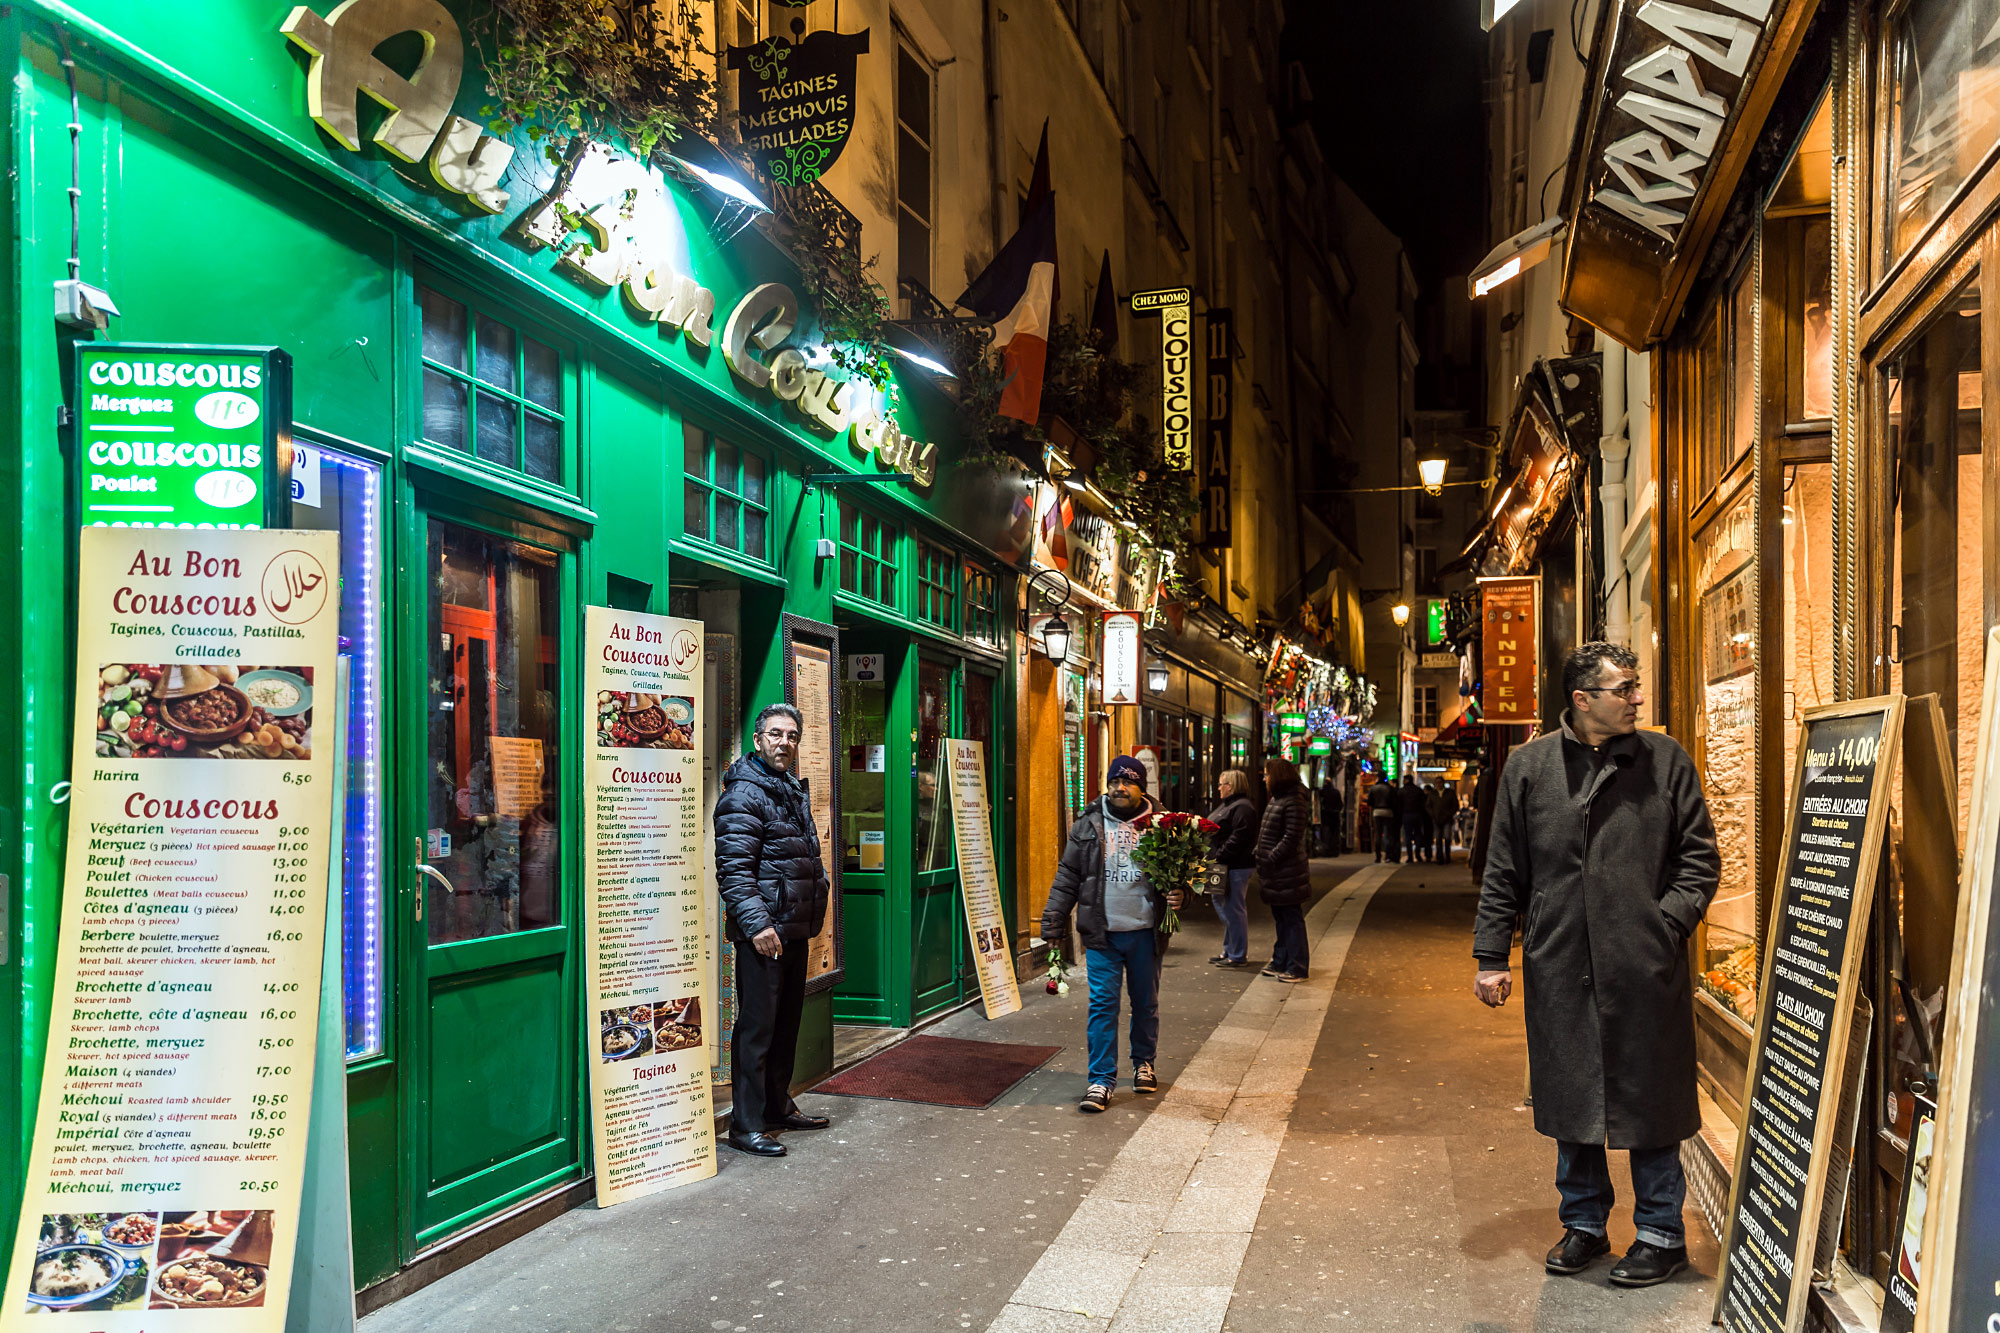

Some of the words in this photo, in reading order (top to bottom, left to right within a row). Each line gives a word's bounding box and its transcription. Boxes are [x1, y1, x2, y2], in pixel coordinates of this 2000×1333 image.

[757, 73, 838, 104] TAGINES
[750, 118, 849, 151] GRILLADES
[1135, 295, 1158, 306] CHEZ
[1159, 292, 1187, 304] MOMO
[89, 362, 261, 388] couscous
[91, 395, 173, 415] Merguez
[88, 441, 261, 468] couscous
[1209, 374, 1229, 533] BAR
[91, 474, 157, 492] Poulet
[128, 550, 172, 576] Au
[183, 551, 241, 578] Bon
[113, 587, 256, 616] Couscous
[111, 623, 165, 637] Tagines,
[172, 624, 236, 637] Couscous,
[244, 626, 304, 638] Pastillas,
[610, 623, 630, 640] Au
[636, 626, 662, 644] Bon
[176, 645, 240, 657] Grillades
[603, 645, 669, 666] Couscous
[602, 666, 626, 675] Tagines,
[1498, 622, 1518, 713] INDIEN
[633, 681, 662, 690] Grillades
[1805, 748, 1829, 767] Menu
[1829, 747, 1835, 767] à
[955, 759, 980, 771] Couscous
[94, 770, 138, 781] Harira
[283, 772, 311, 785] 6,50
[613, 767, 681, 784] Couscous
[125, 792, 278, 819] Couscous
[1803, 794, 1832, 812] ENTRÉES
[1831, 798, 1843, 812] AU
[1843, 798, 1868, 814] CHOIX
[91, 823, 163, 836] Végétarien
[280, 827, 309, 837] 9,00
[1811, 816, 1828, 828] Starters
[1833, 818, 1849, 830] choice
[89, 839, 145, 852] Merguez
[150, 843, 158, 851] (3
[162, 842, 192, 851] pièces)
[278, 843, 308, 851] 11,00
[88, 855, 125, 868] Bœuf
[130, 859, 151, 867] (Beef
[274, 858, 307, 869] 13,00
[87, 871, 130, 881] Poulet
[275, 874, 306, 883] 11,00
[1105, 870, 1142, 882] PARIS
[86, 887, 148, 897] Boulettes
[274, 890, 305, 898] 11,00
[84, 902, 118, 913] Côtes
[124, 903, 188, 916] d'agneau
[194, 906, 202, 915] (3
[206, 906, 238, 915] pièces)
[270, 906, 304, 916] 14,00
[81, 930, 135, 940] Berbere
[268, 930, 302, 941] 16,00
[76, 981, 142, 992] Brochette
[147, 981, 211, 994] d'agneau
[264, 983, 298, 994] 14,00
[73, 1009, 142, 1020] Brochette,
[149, 1009, 177, 1019] côte
[183, 1009, 247, 1022] d'agneau
[261, 1008, 296, 1019] 16,00
[1776, 990, 1795, 1012] PLATS
[1794, 1000, 1805, 1016] AU
[1804, 1004, 1826, 1028] CHOIX
[1776, 1010, 1786, 1024] Main
[1805, 1026, 1819, 1043] choice
[69, 1037, 139, 1048] Brochette,
[147, 1039, 204, 1050] merguez
[259, 1039, 293, 1049] 15,00
[65, 1066, 117, 1076] Maison
[257, 1067, 291, 1077] 17,00
[633, 1063, 677, 1081] Tagines
[603, 1084, 640, 1096] Végétarien
[61, 1094, 123, 1105] Méchoui
[253, 1095, 288, 1106] 19,50
[60, 1111, 99, 1124] Royal
[251, 1109, 286, 1120] 18,00
[604, 1110, 631, 1120] Agneau
[57, 1127, 119, 1141] Impérial
[249, 1128, 284, 1139] 19,50
[606, 1126, 627, 1137] Tajine
[607, 1149, 628, 1161] Confit
[629, 1147, 638, 1155] de
[639, 1140, 663, 1153] canard
[608, 1162, 646, 1177] Marrakech
[48, 1181, 113, 1193] Méchoui,
[121, 1180, 181, 1194] merguez
[240, 1181, 278, 1192] 20,50
[1739, 1204, 1766, 1245] DESSERTS
[1763, 1234, 1774, 1254] AU
[1773, 1244, 1794, 1277] CHOIX
[1891, 1274, 1918, 1316] Cuisses
